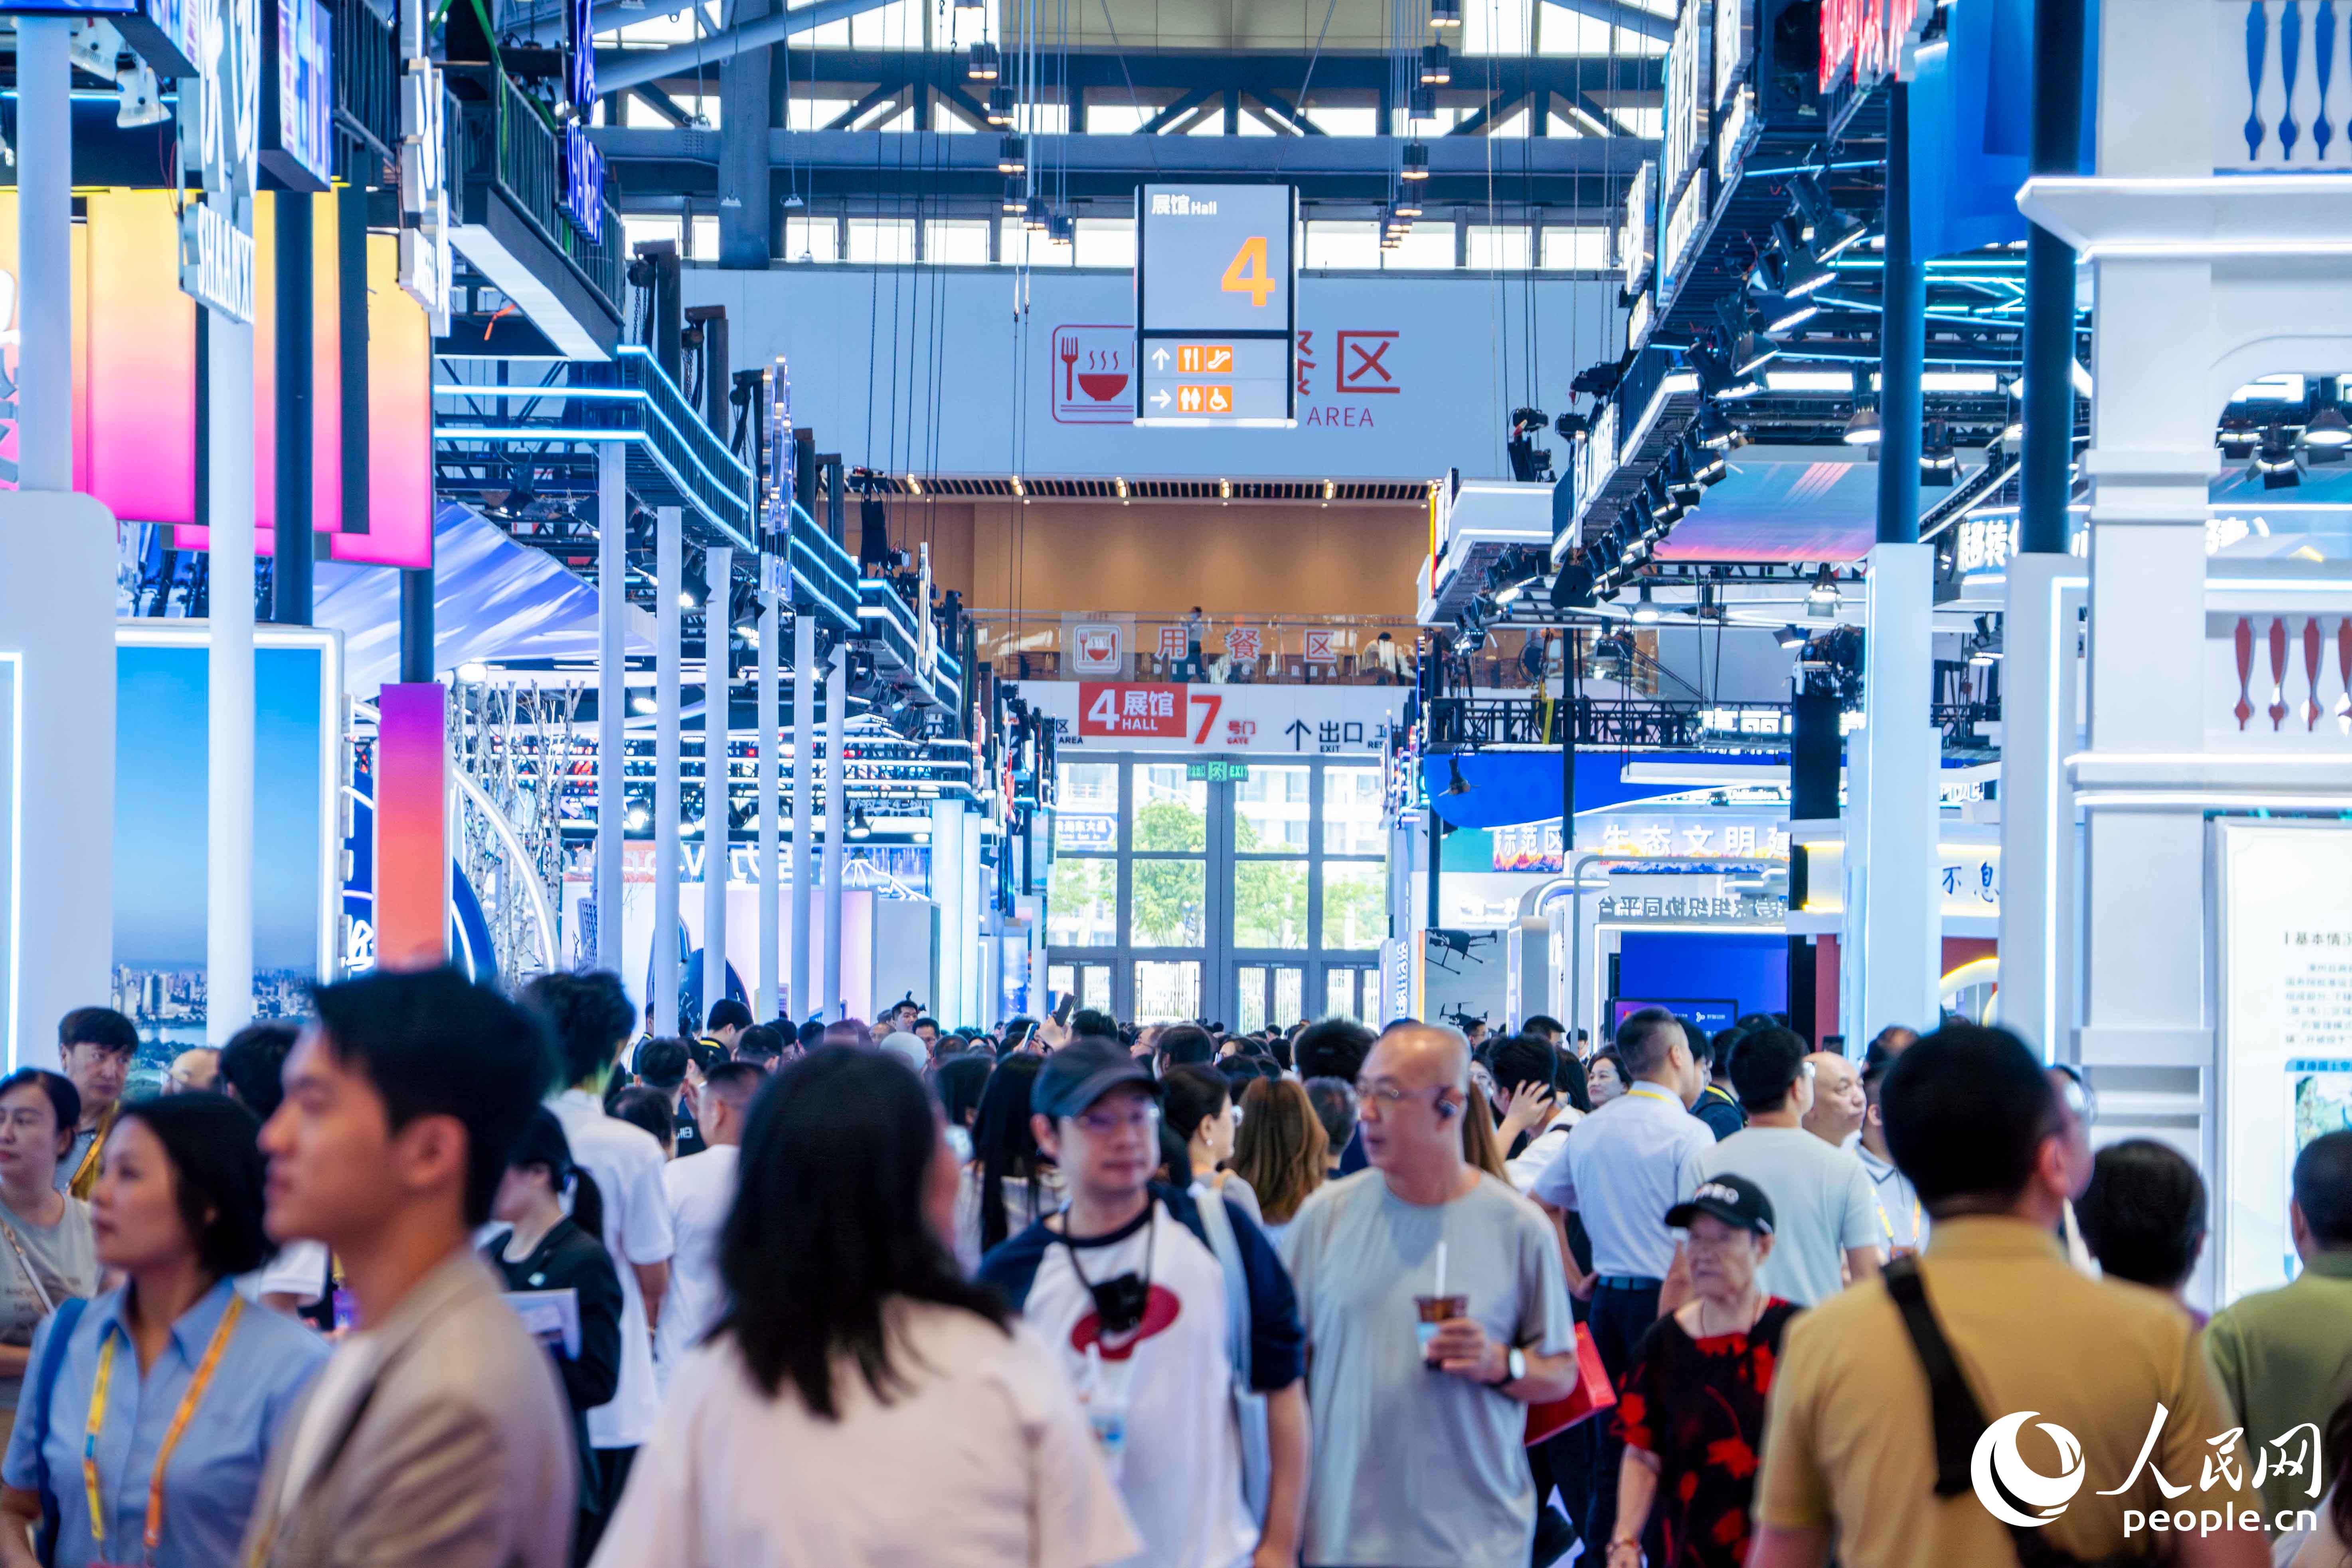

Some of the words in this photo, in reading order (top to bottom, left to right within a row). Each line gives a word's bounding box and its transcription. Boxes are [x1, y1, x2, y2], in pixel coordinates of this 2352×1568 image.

[567, 117, 602, 246] SHANGHAI
[1152, 194, 1190, 216] 展馆
[1191, 201, 1217, 215] Hall
[198, 202, 255, 323] SHAANXI
[1221, 237, 1276, 306] 4
[1307, 407, 1374, 427] AREA
[1156, 627, 1338, 662] 用餐区
[1088, 689, 1120, 731] 4
[1123, 690, 1174, 717] 展馆
[1122, 718, 1158, 731] HALL
[1191, 694, 1222, 744] 7
[1227, 720, 1256, 735] 号门
[1319, 720, 1362, 743] 出口
[1229, 765, 1247, 778] EXIT
[1942, 861, 2000, 903] 不息
